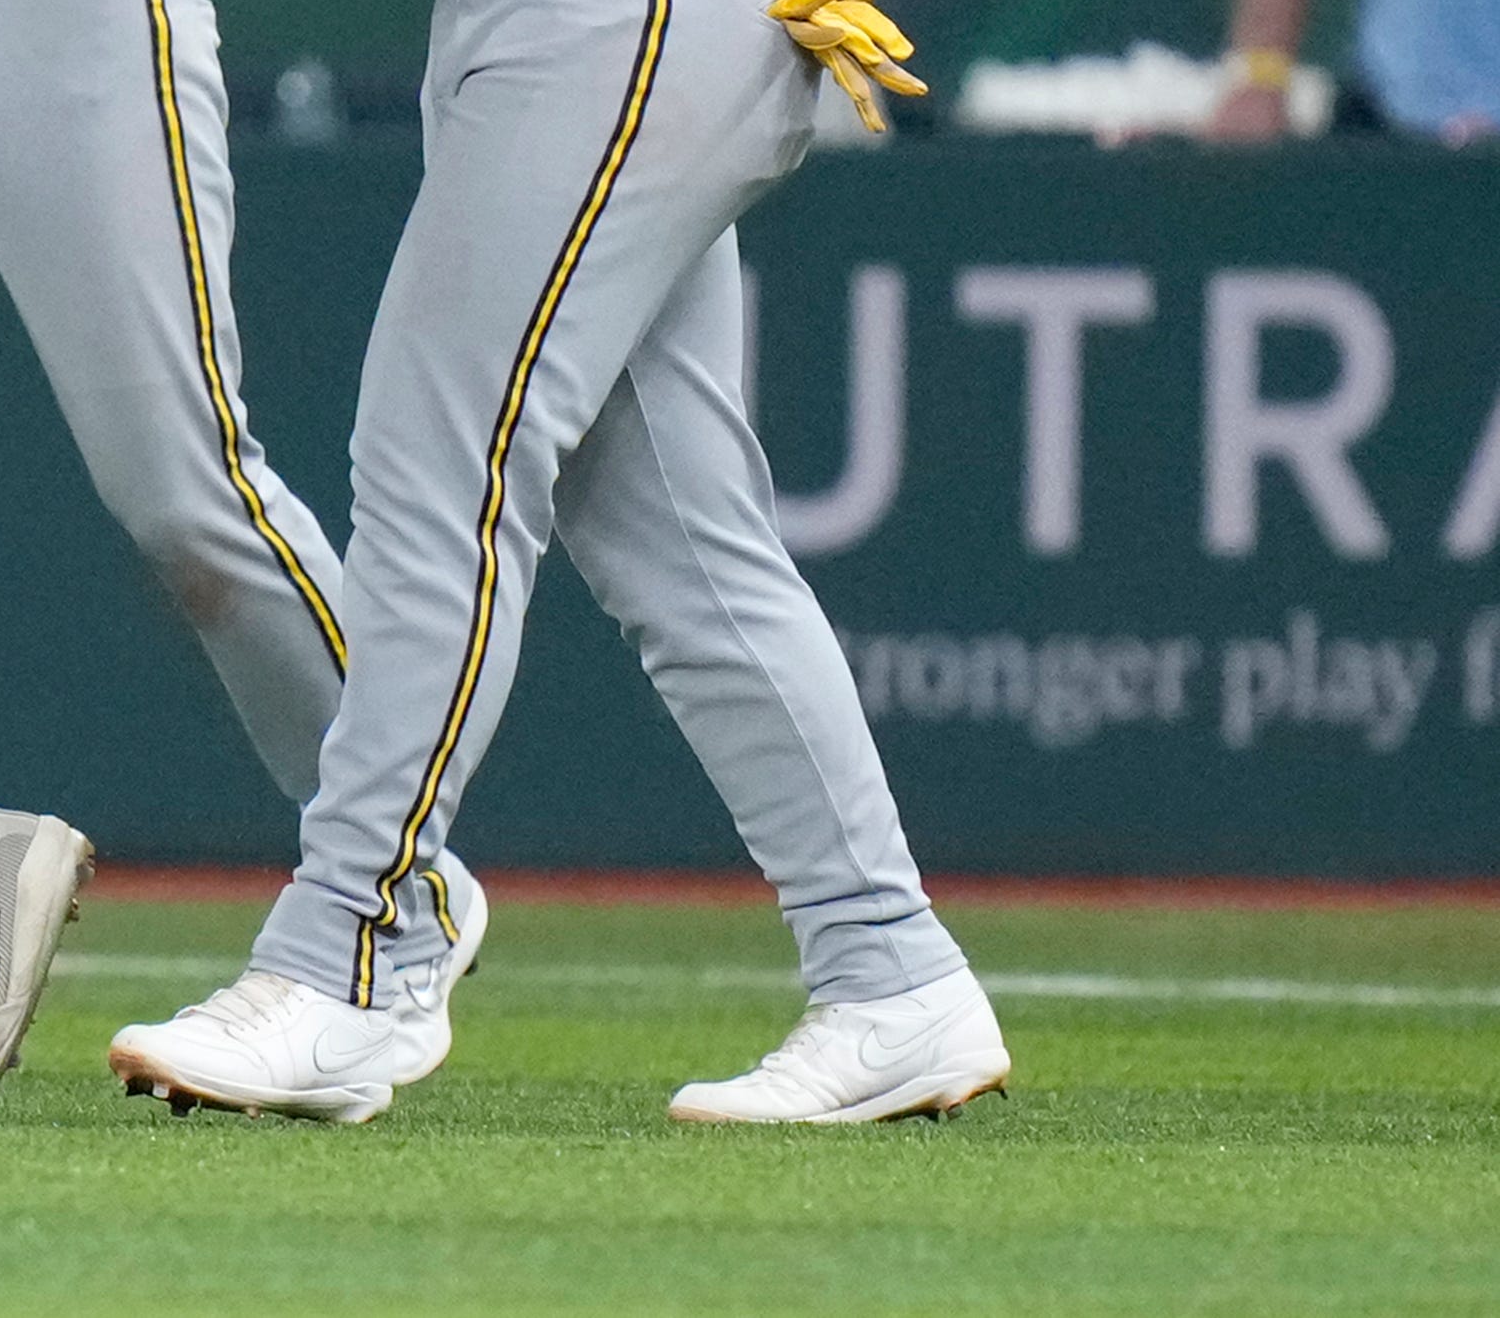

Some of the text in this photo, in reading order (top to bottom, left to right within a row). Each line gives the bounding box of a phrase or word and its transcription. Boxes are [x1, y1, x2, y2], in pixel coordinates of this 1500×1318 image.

[741, 262, 1500, 562] UTR
[835, 627, 1195, 748] ronger
[1222, 608, 1436, 752] play
